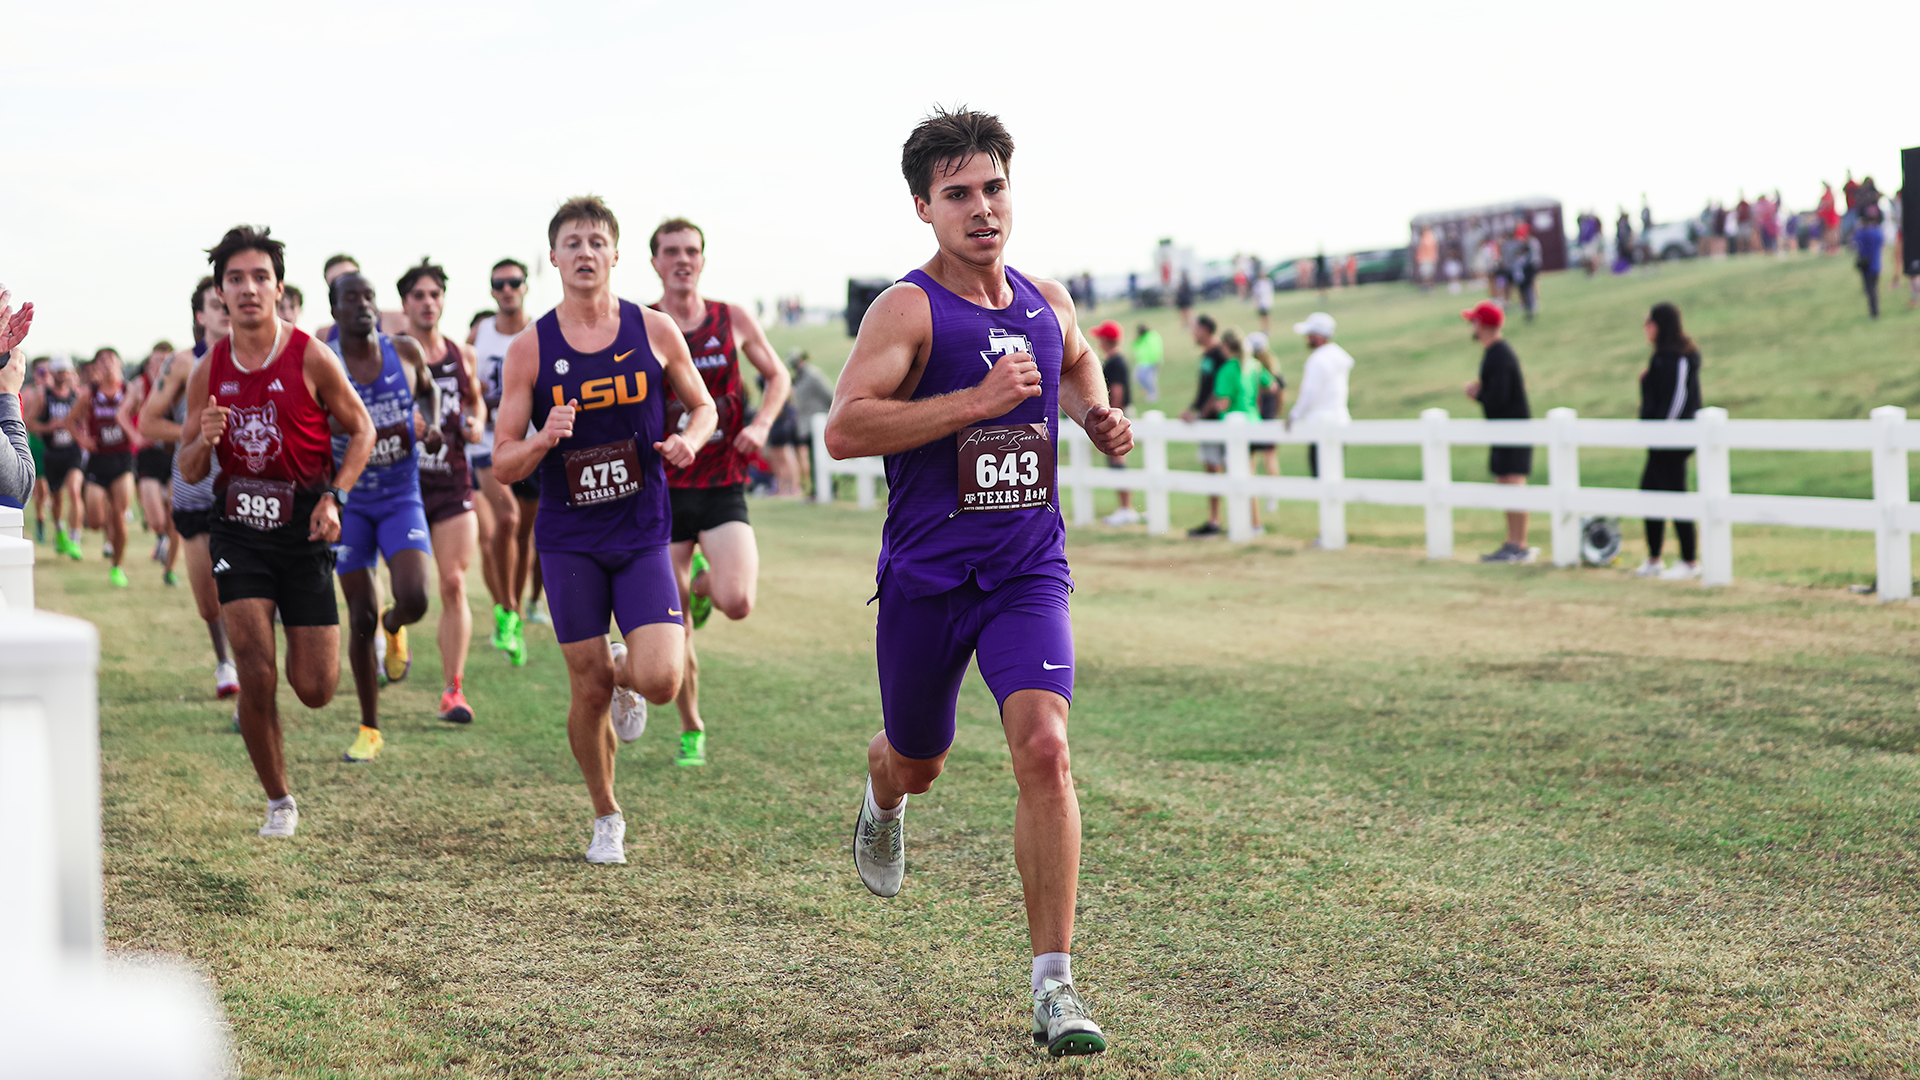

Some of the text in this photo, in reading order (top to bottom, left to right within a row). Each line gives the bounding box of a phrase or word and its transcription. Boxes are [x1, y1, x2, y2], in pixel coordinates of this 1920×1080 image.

[552, 371, 648, 411] LSU
[580, 459, 628, 489] 475
[976, 451, 1039, 488] 643
[236, 493, 281, 520] 393
[583, 486, 616, 501] TEXAS
[977, 490, 1020, 504] TEXAS
[1024, 487, 1048, 501] A&M
